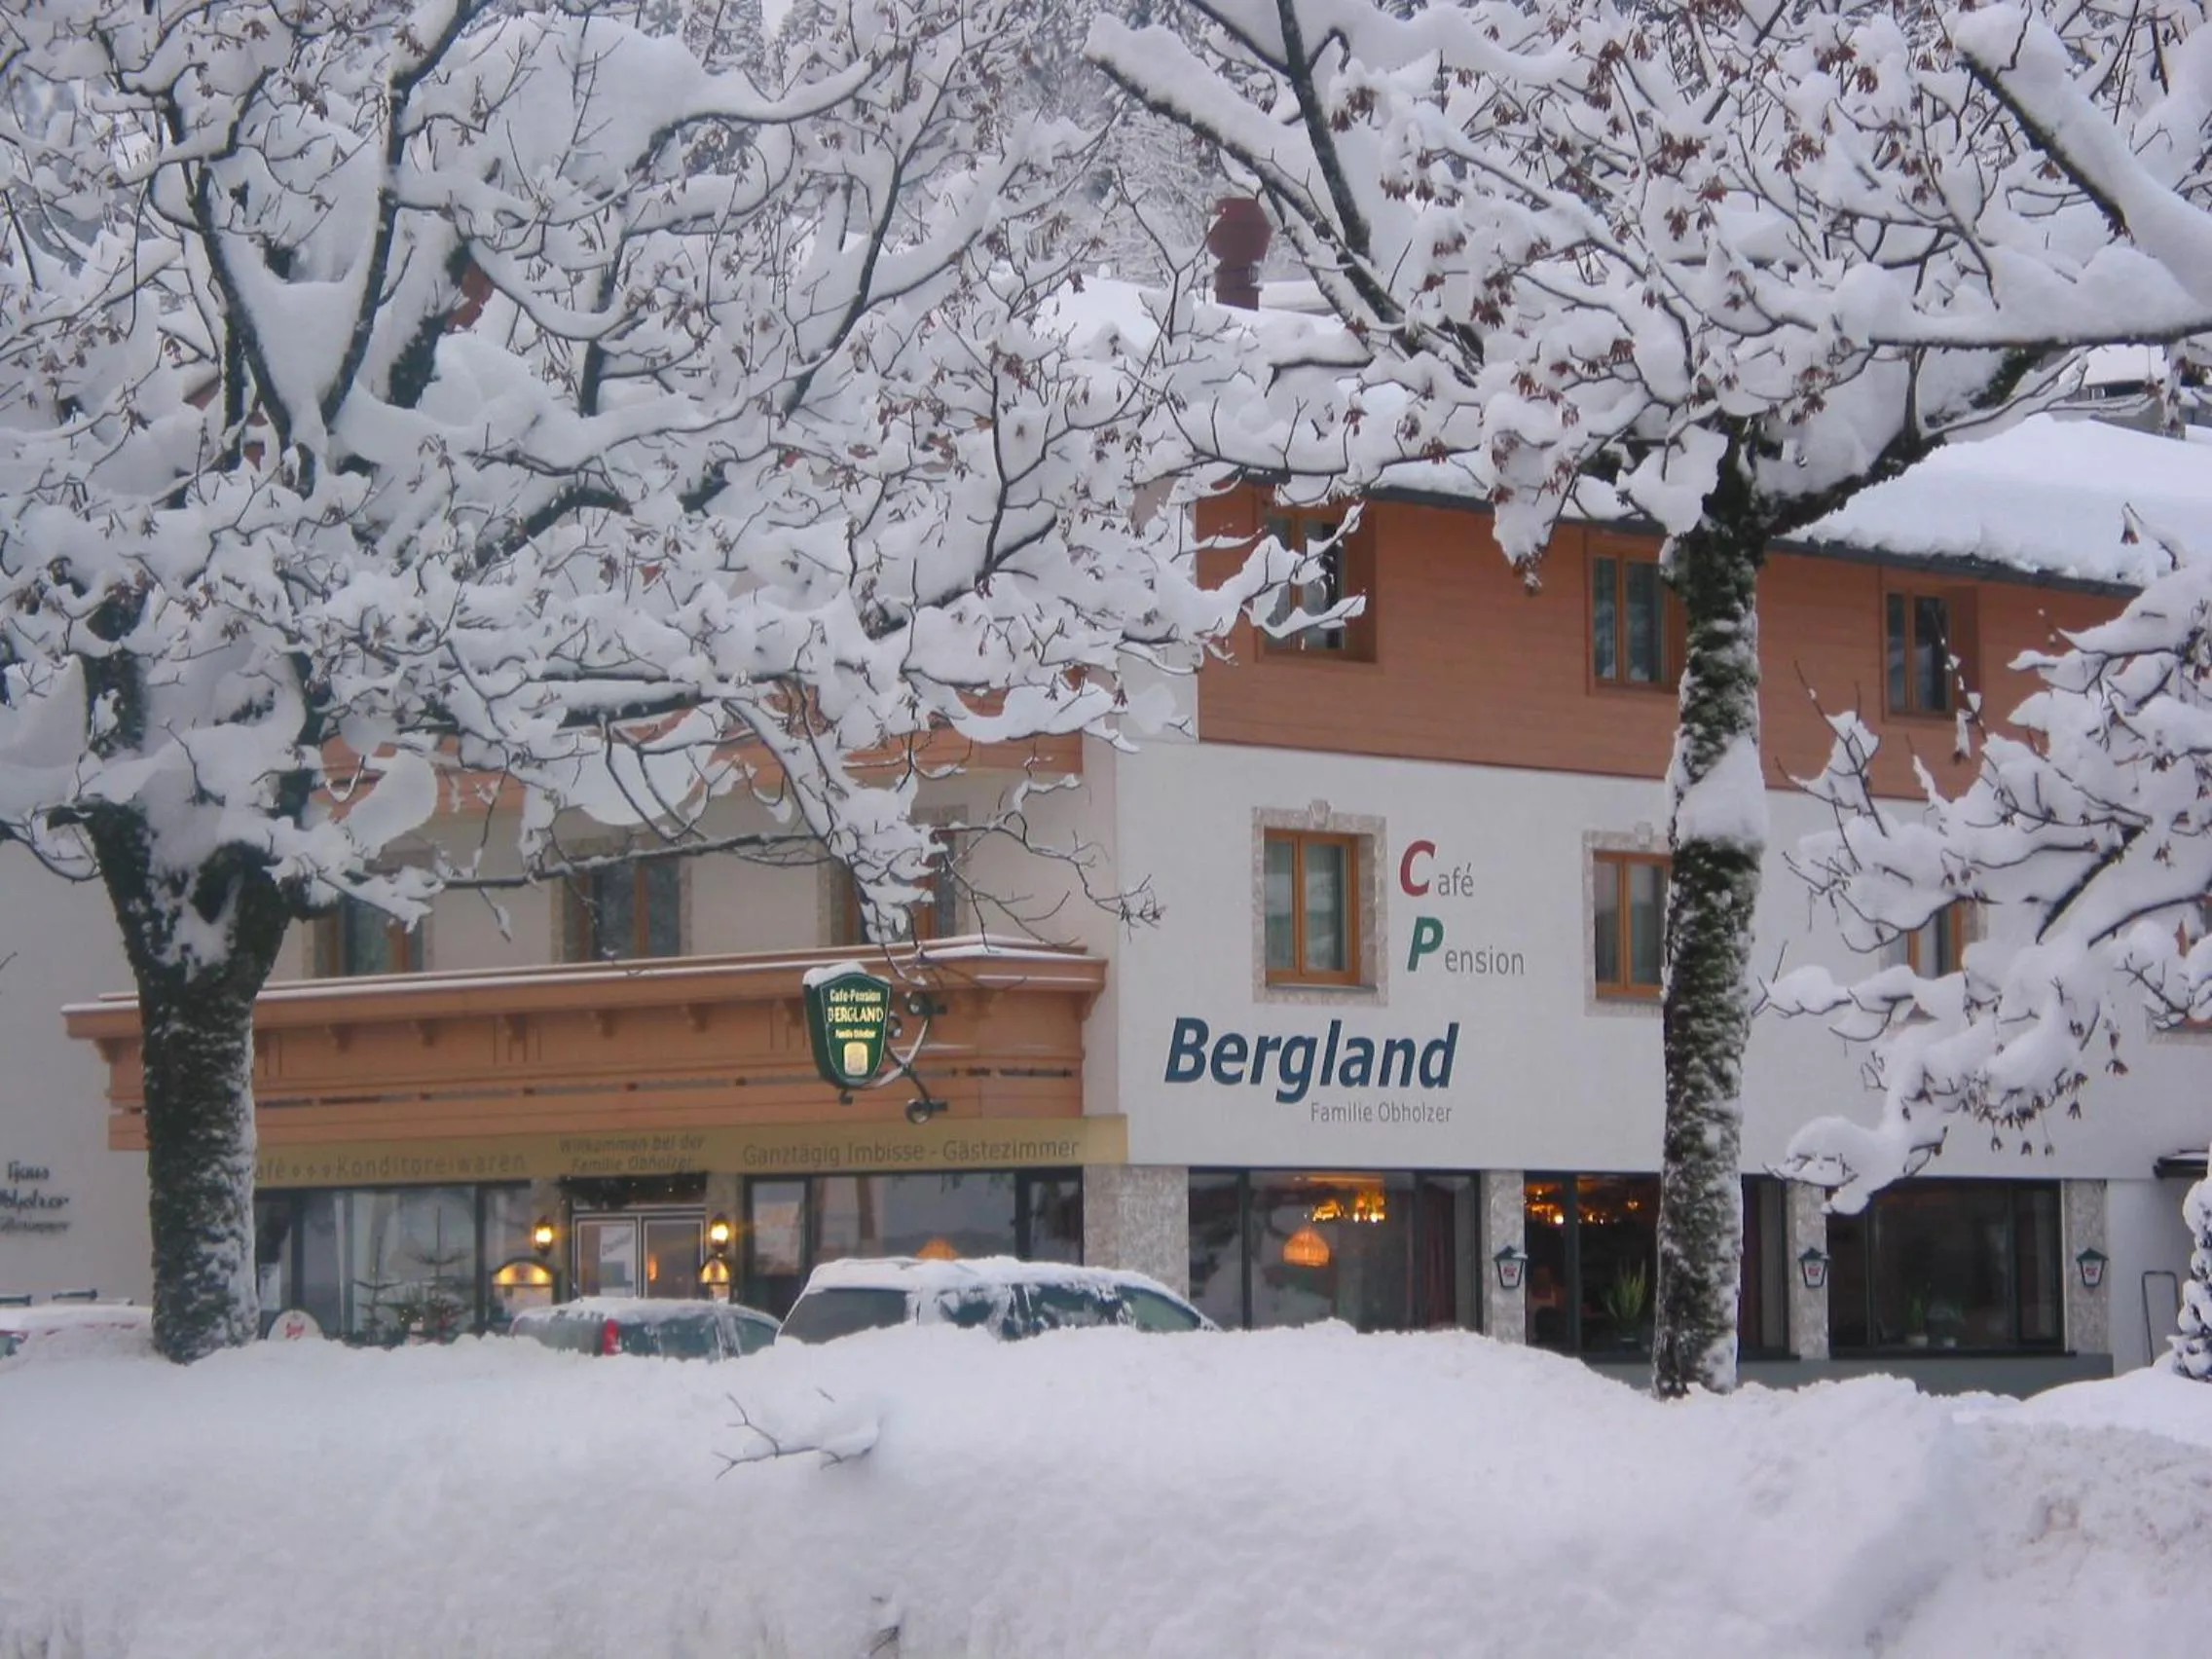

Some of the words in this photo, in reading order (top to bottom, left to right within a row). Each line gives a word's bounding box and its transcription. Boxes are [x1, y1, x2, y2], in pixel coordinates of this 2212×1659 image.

[1400, 839, 1474, 898] Café
[1407, 916, 1525, 976] Pension
[827, 1007, 884, 1022] BERGLAND
[1164, 1017, 1459, 1103] Bergland
[1310, 1102, 1373, 1122] Familie
[1378, 1102, 1452, 1123] Obholzer
[337, 1154, 527, 1180] Konditoreiwaren
[743, 1143, 840, 1168] Ganztägig
[848, 1140, 923, 1163] Imbisse
[943, 1138, 1080, 1162] Gästezimmer
